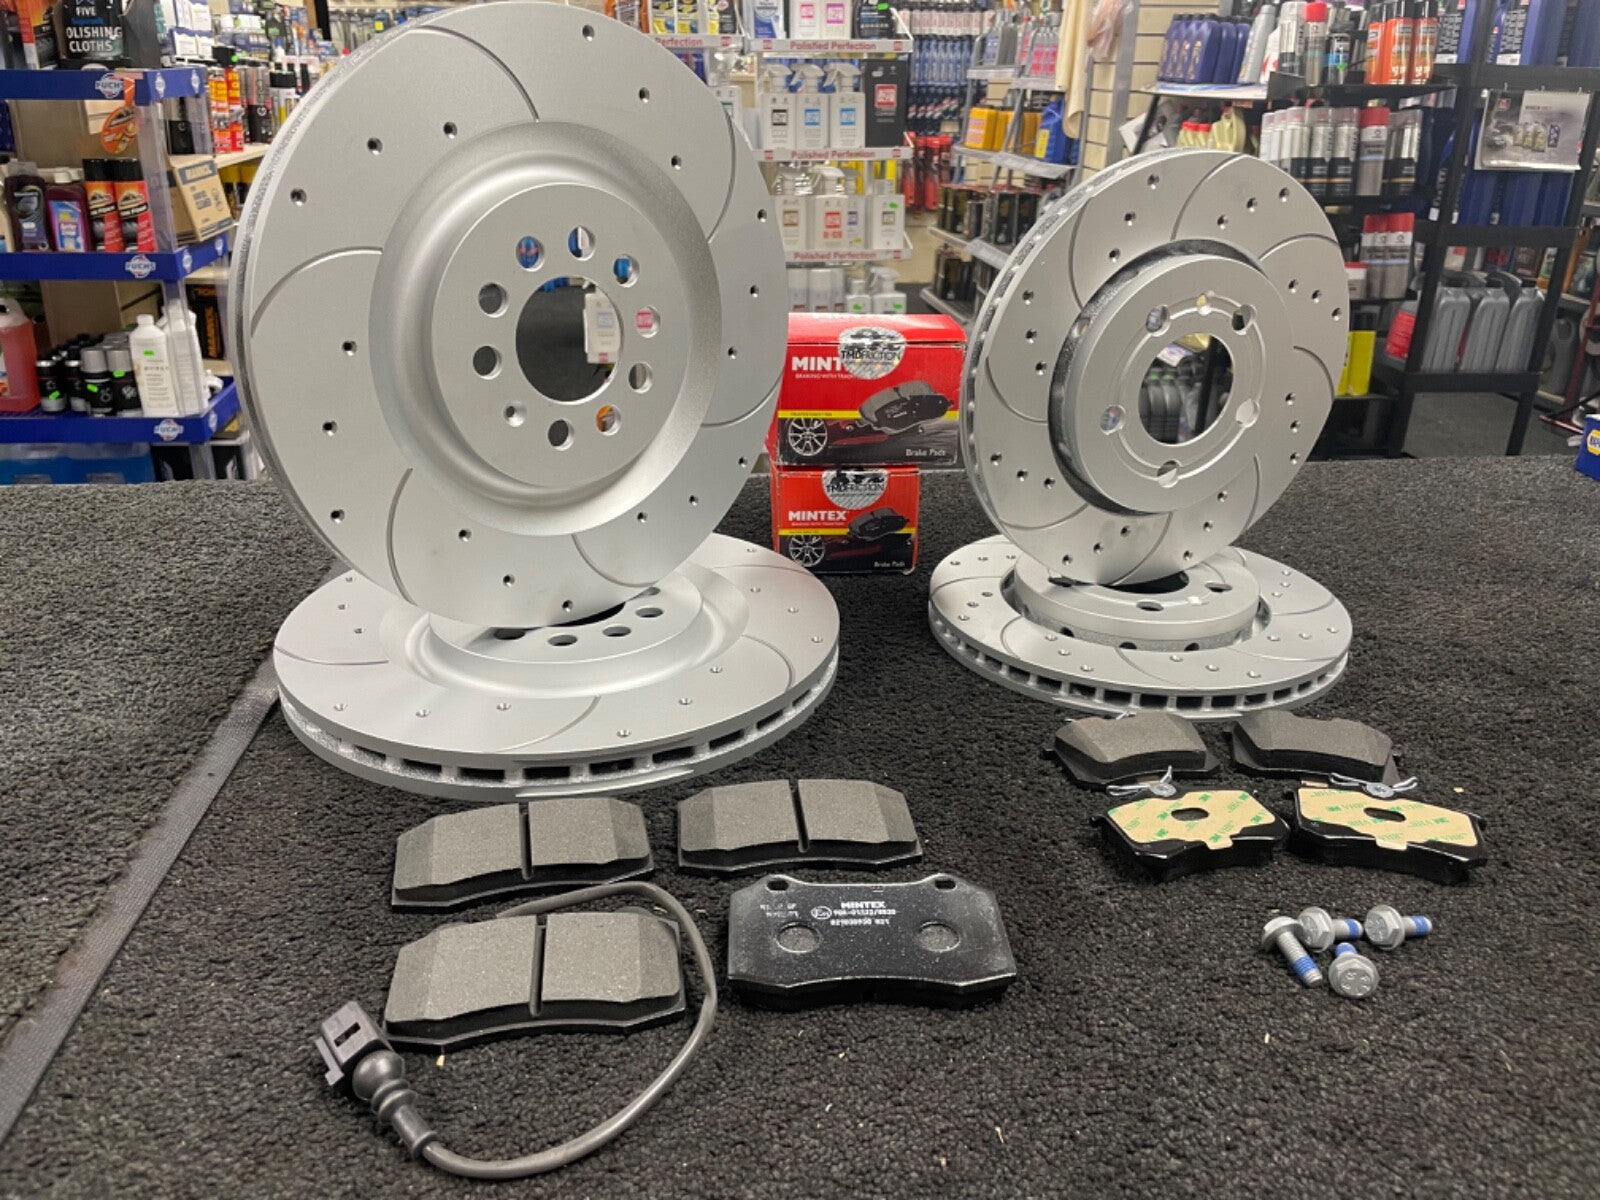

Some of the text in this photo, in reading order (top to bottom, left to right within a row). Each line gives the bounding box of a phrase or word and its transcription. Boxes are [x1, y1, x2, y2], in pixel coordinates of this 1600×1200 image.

[75, 6, 96, 16] FIVE
[66, 26, 122, 38] OLISHING
[69, 40, 113, 53] CLOTHS
[790, 41, 877, 50] Polished Perfection
[791, 150, 829, 159] Polished
[125, 261, 156, 271] FUCHS
[791, 356, 842, 371] MINT
[906, 449, 927, 457] Brake
[788, 511, 847, 521] MINTEX
[840, 901, 887, 909] MINTEX
